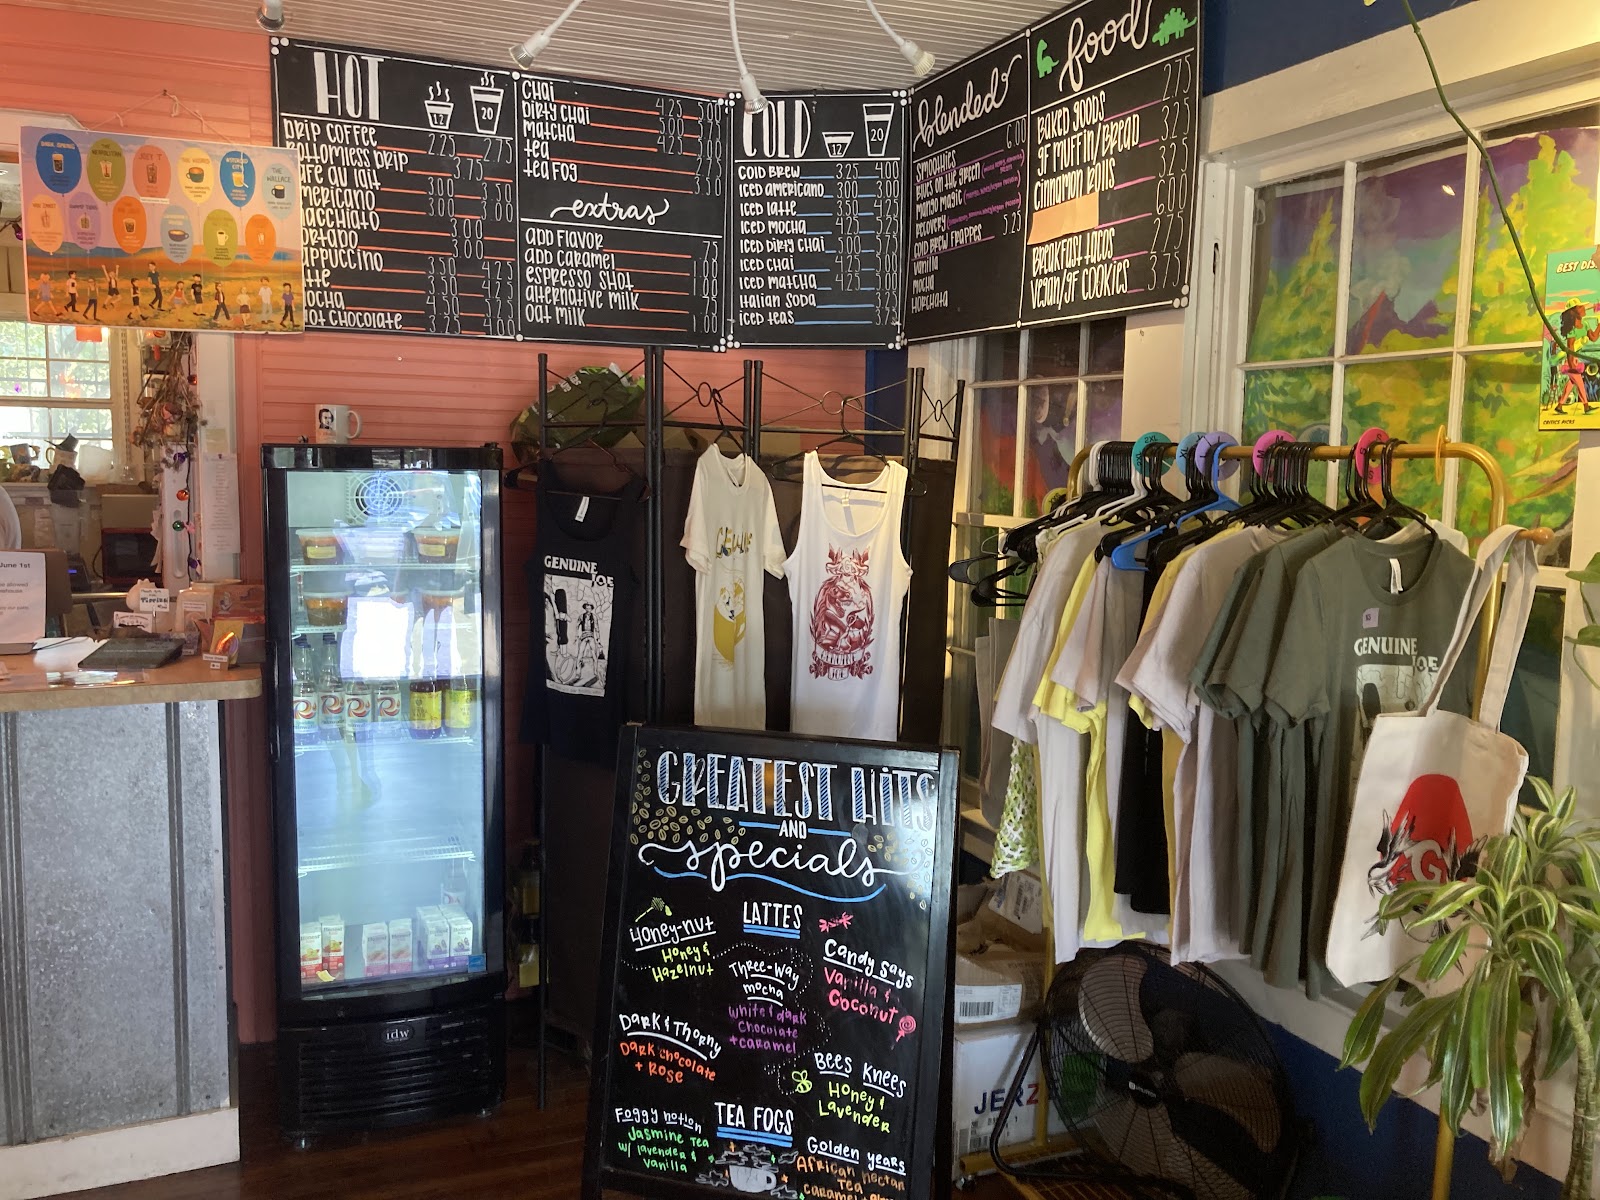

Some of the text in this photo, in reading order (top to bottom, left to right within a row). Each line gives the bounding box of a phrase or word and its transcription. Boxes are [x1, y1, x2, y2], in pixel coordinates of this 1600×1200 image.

[1059, 0, 1152, 92] food
[313, 51, 385, 121] HOT
[1162, 54, 1192, 102] 2.75
[656, 97, 682, 117] 4.25
[913, 54, 1022, 152] blended
[433, 113, 444, 125] 12
[481, 107, 494, 120] 20
[659, 118, 684, 136] 5.00
[742, 100, 811, 158] COLD
[870, 127, 884, 142] 20
[428, 133, 456, 157] 2.25
[832, 143, 842, 156] 12
[1159, 136, 1189, 178] 3.25
[266, 175, 291, 183] WALLACE
[453, 157, 483, 181] 3.75
[835, 162, 859, 180] 3.25
[428, 177, 455, 198] 3.00
[695, 177, 722, 196] 3.50
[836, 181, 859, 199] 3.00
[1156, 172, 1188, 216] 6.00
[428, 198, 456, 217] 3.00
[481, 200, 513, 222] 3.00
[550, 192, 670, 226] extras
[836, 199, 859, 217] 3.50
[873, 199, 900, 217] 4.25
[876, 216, 900, 235] 5.25
[1002, 209, 1022, 236] 5.25
[451, 239, 484, 260] 3.00
[837, 236, 861, 255] 5.00
[428, 256, 456, 277] 3.50
[835, 255, 861, 273] 4.25
[876, 253, 899, 273] 5.00
[1147, 251, 1181, 290] 3.75
[1556, 261, 1579, 274] BEST
[428, 276, 458, 296] 3.50
[482, 281, 513, 300] 4.25
[876, 272, 899, 291] 5.00
[485, 299, 513, 319] 5.25
[875, 292, 899, 310] 3.25
[429, 316, 461, 335] 3.25
[1144, 435, 1158, 444] 2XL
[1179, 447, 1189, 459] XL
[1257, 449, 1265, 459] M
[1368, 470, 1374, 479] S
[544, 555, 598, 575] GENUINE
[591, 573, 614, 588] JOE
[1353, 636, 1418, 656] GENUINE
[1411, 655, 1440, 673] JOE
[656, 750, 838, 822] GREATEST
[779, 819, 808, 840] AND
[637, 838, 912, 893] specials
[1404, 839, 1443, 884] G
[743, 901, 803, 929] LATTES
[824, 938, 875, 978] Candy
[386, 1028, 410, 1041] idw
[813, 1052, 907, 1099] Bees Knees
[714, 1101, 794, 1136] TEA FOGS
[627, 1125, 685, 1144] Jasmine
[807, 1136, 860, 1160] Golden
